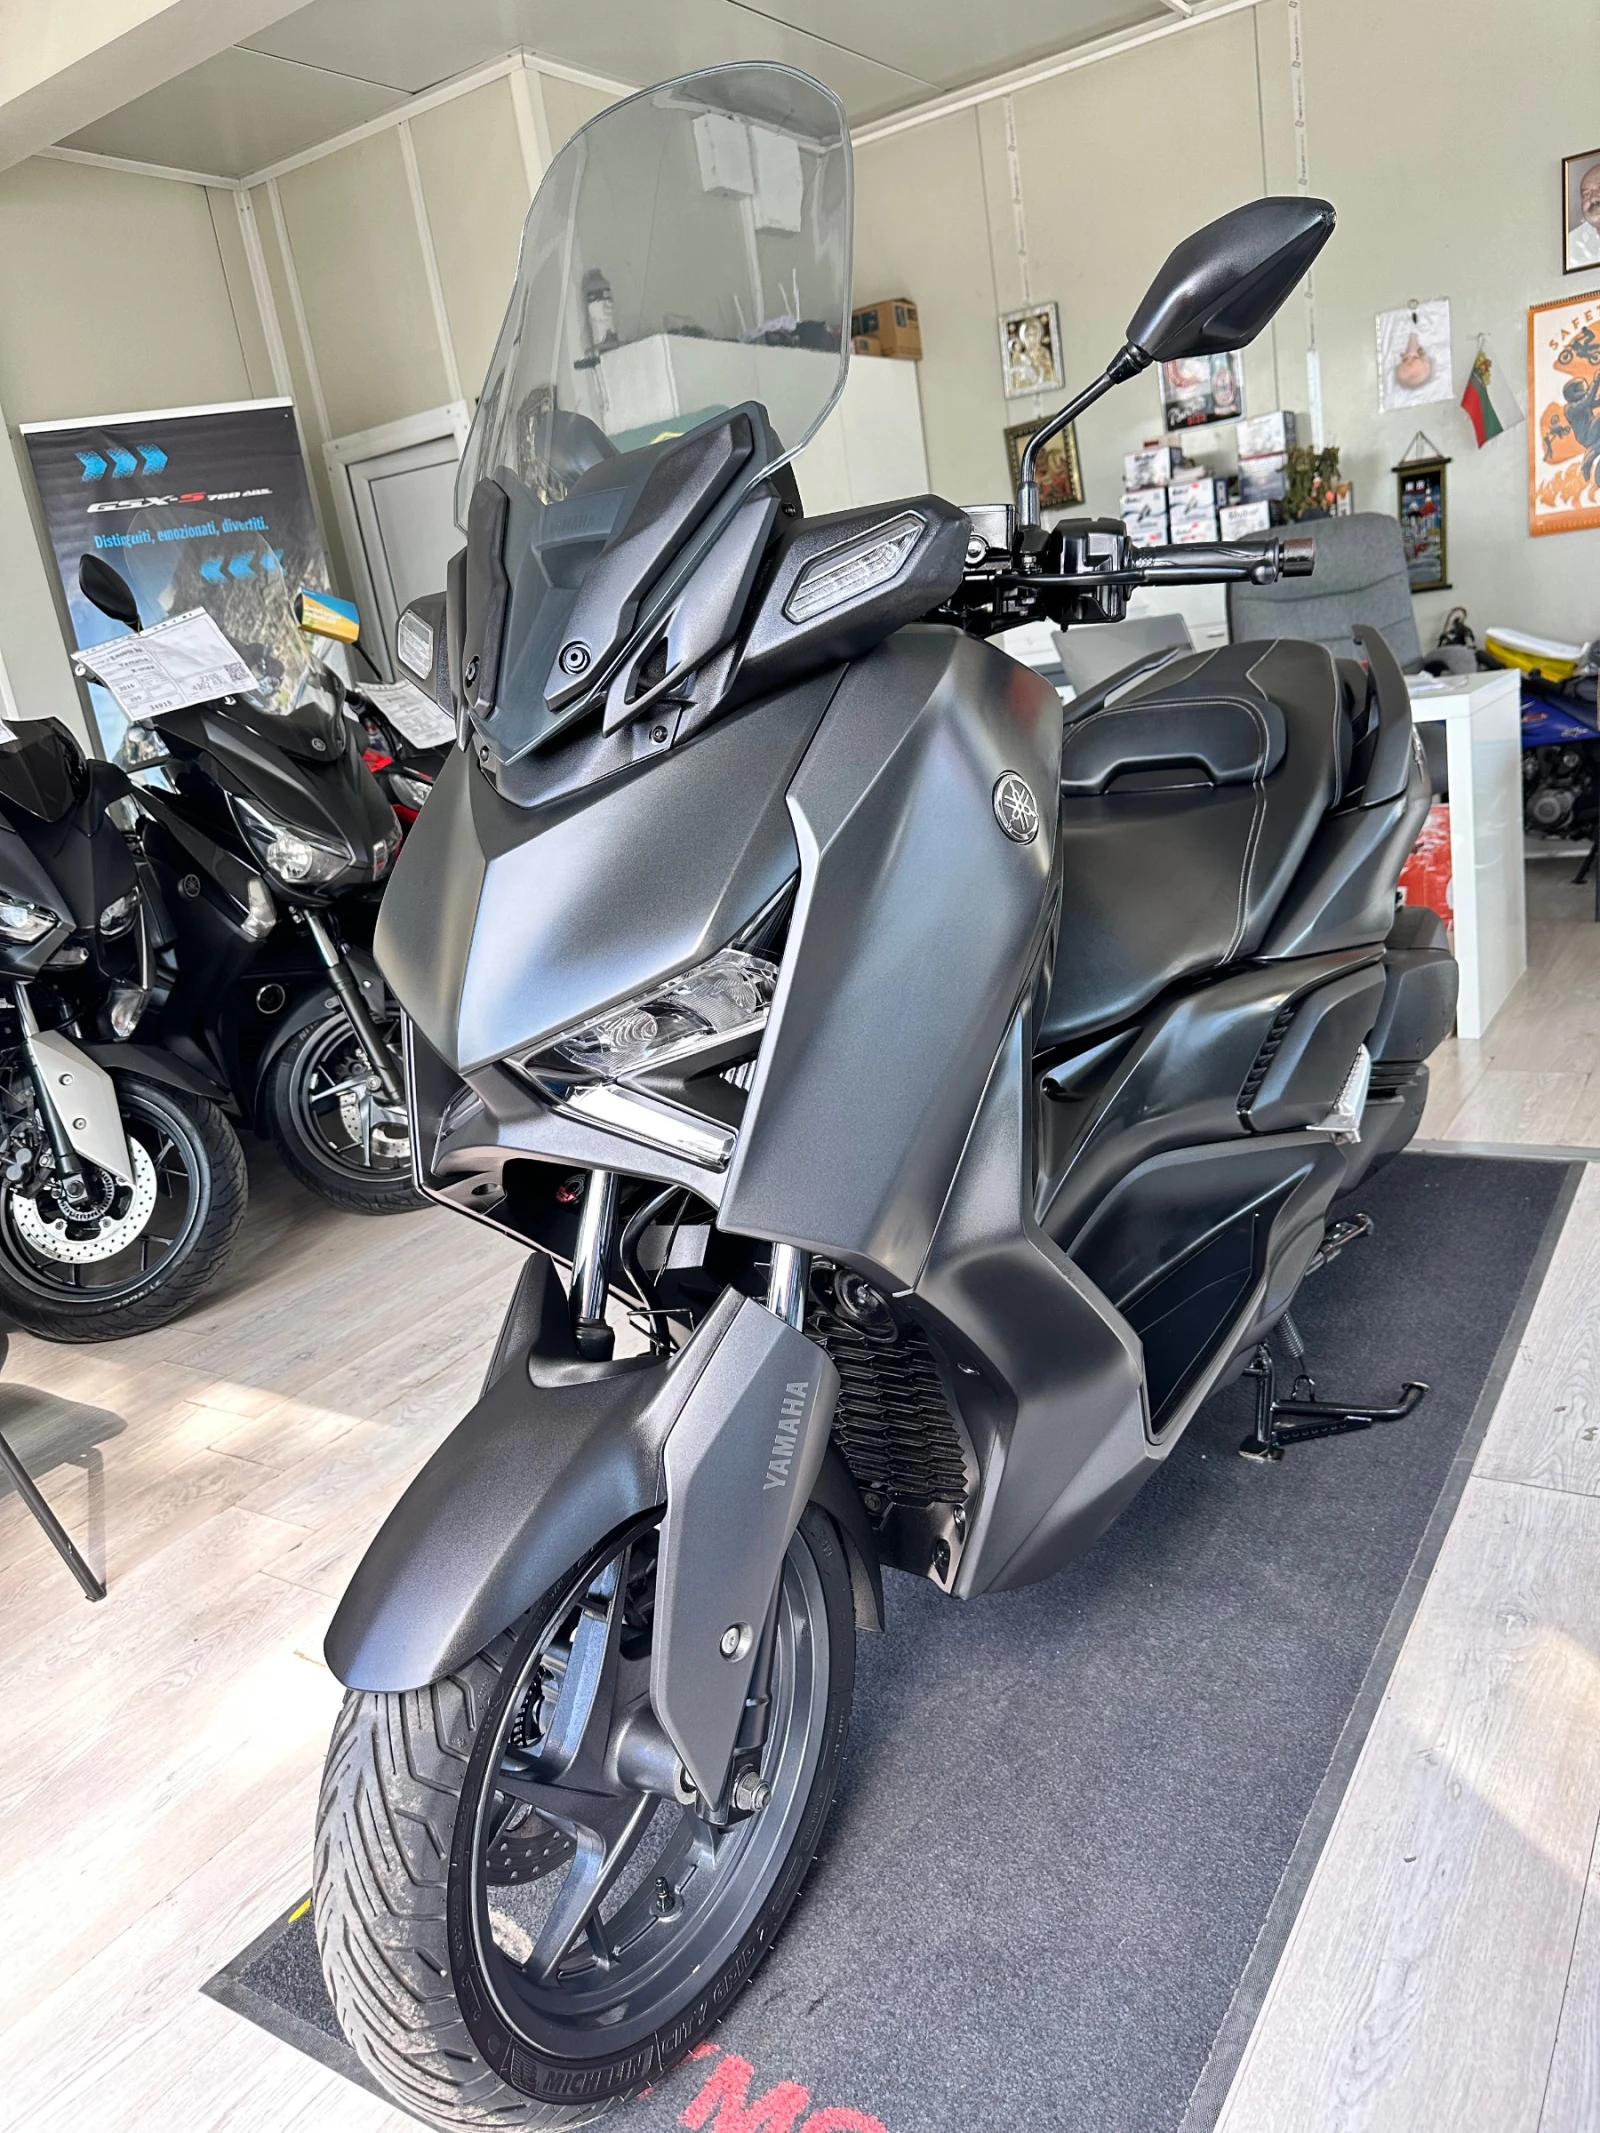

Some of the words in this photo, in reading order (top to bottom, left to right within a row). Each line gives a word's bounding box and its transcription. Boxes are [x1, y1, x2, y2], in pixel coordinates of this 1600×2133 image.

[1549, 305, 1600, 351] SAFE
[207, 491, 241, 501] 750
[94, 529, 156, 550] Distinguiti,
[157, 520, 220, 542] emozionati,
[221, 515, 270, 534] divertiti.
[763, 1381, 809, 1490] YAMAHA
[543, 2051, 645, 2095] MICHELIN
[661, 2001, 708, 2054] CITY
[713, 1946, 756, 2003] GRIP
